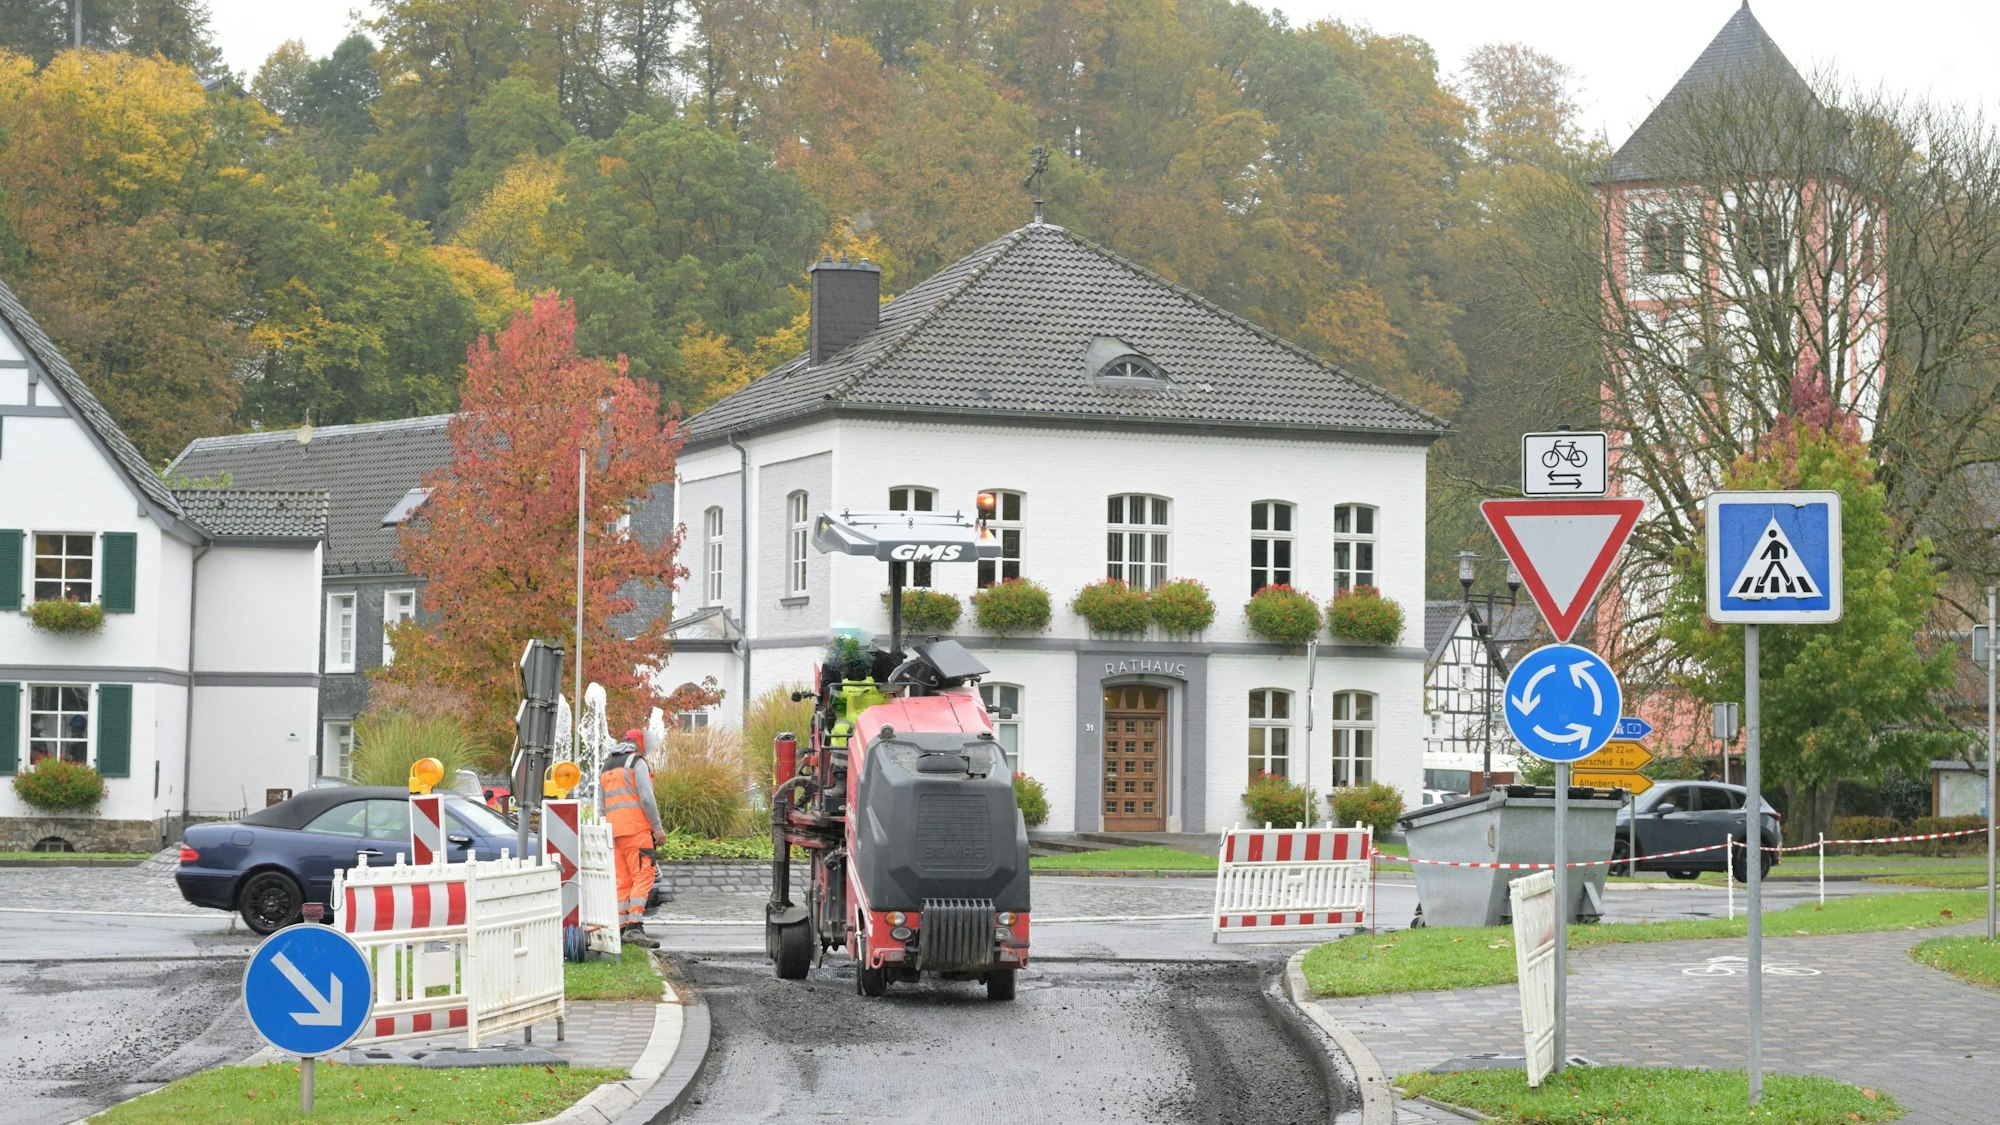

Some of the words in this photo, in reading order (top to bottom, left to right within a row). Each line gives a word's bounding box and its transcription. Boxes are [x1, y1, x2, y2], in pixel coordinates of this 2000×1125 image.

[890, 544, 963, 560] GMS
[1104, 658, 1186, 677] RATHAUS
[1085, 723, 1094, 732] 31
[1616, 745, 1625, 754] 22
[1620, 758, 1625, 766] 8
